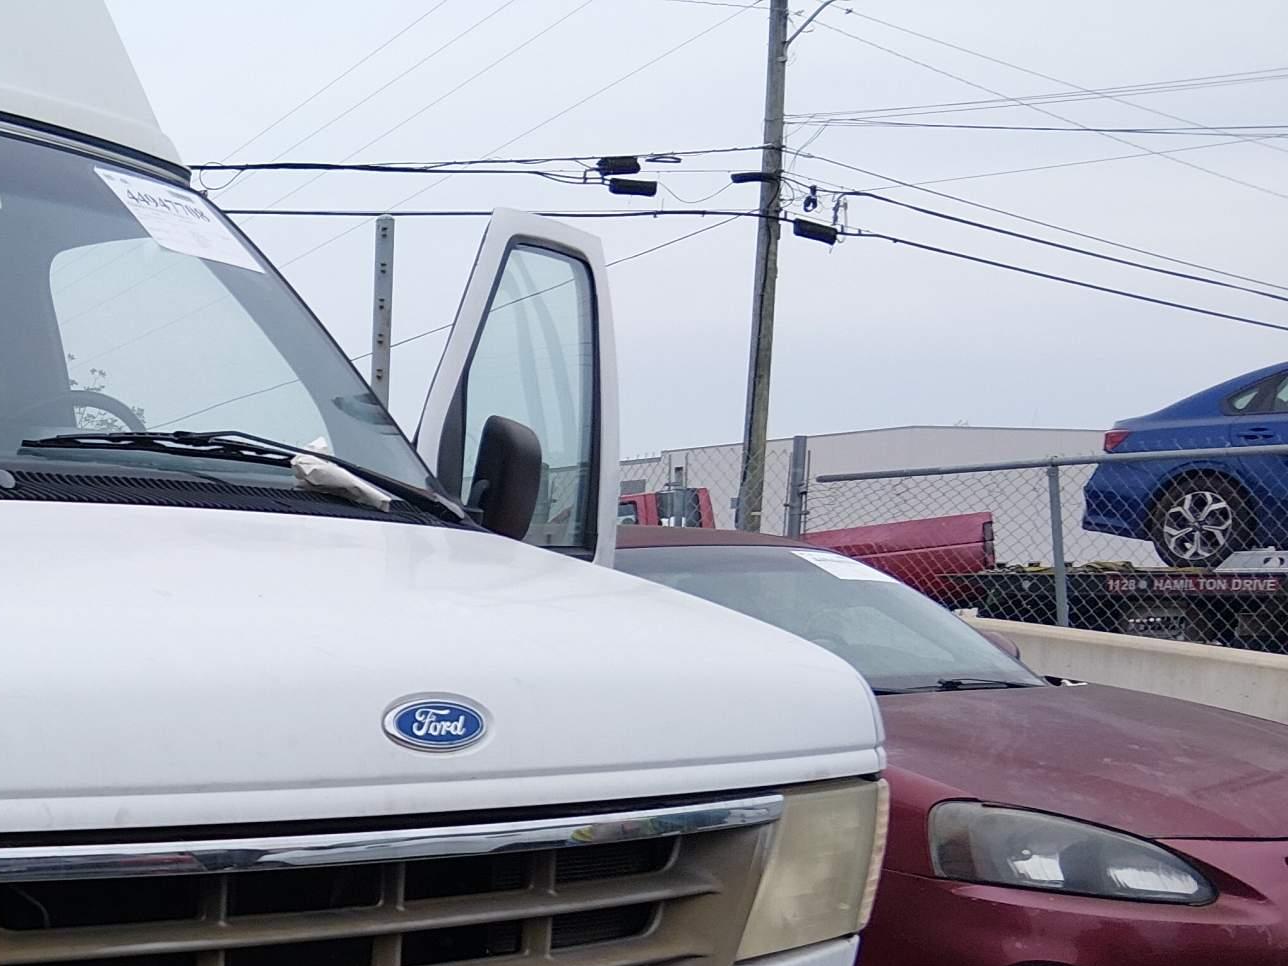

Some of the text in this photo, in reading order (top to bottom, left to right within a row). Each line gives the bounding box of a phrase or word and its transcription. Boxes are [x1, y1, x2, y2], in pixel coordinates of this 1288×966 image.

[1107, 578, 1278, 592] 1128 HAMILTON DRIVE
[412, 708, 466, 736] Ford
